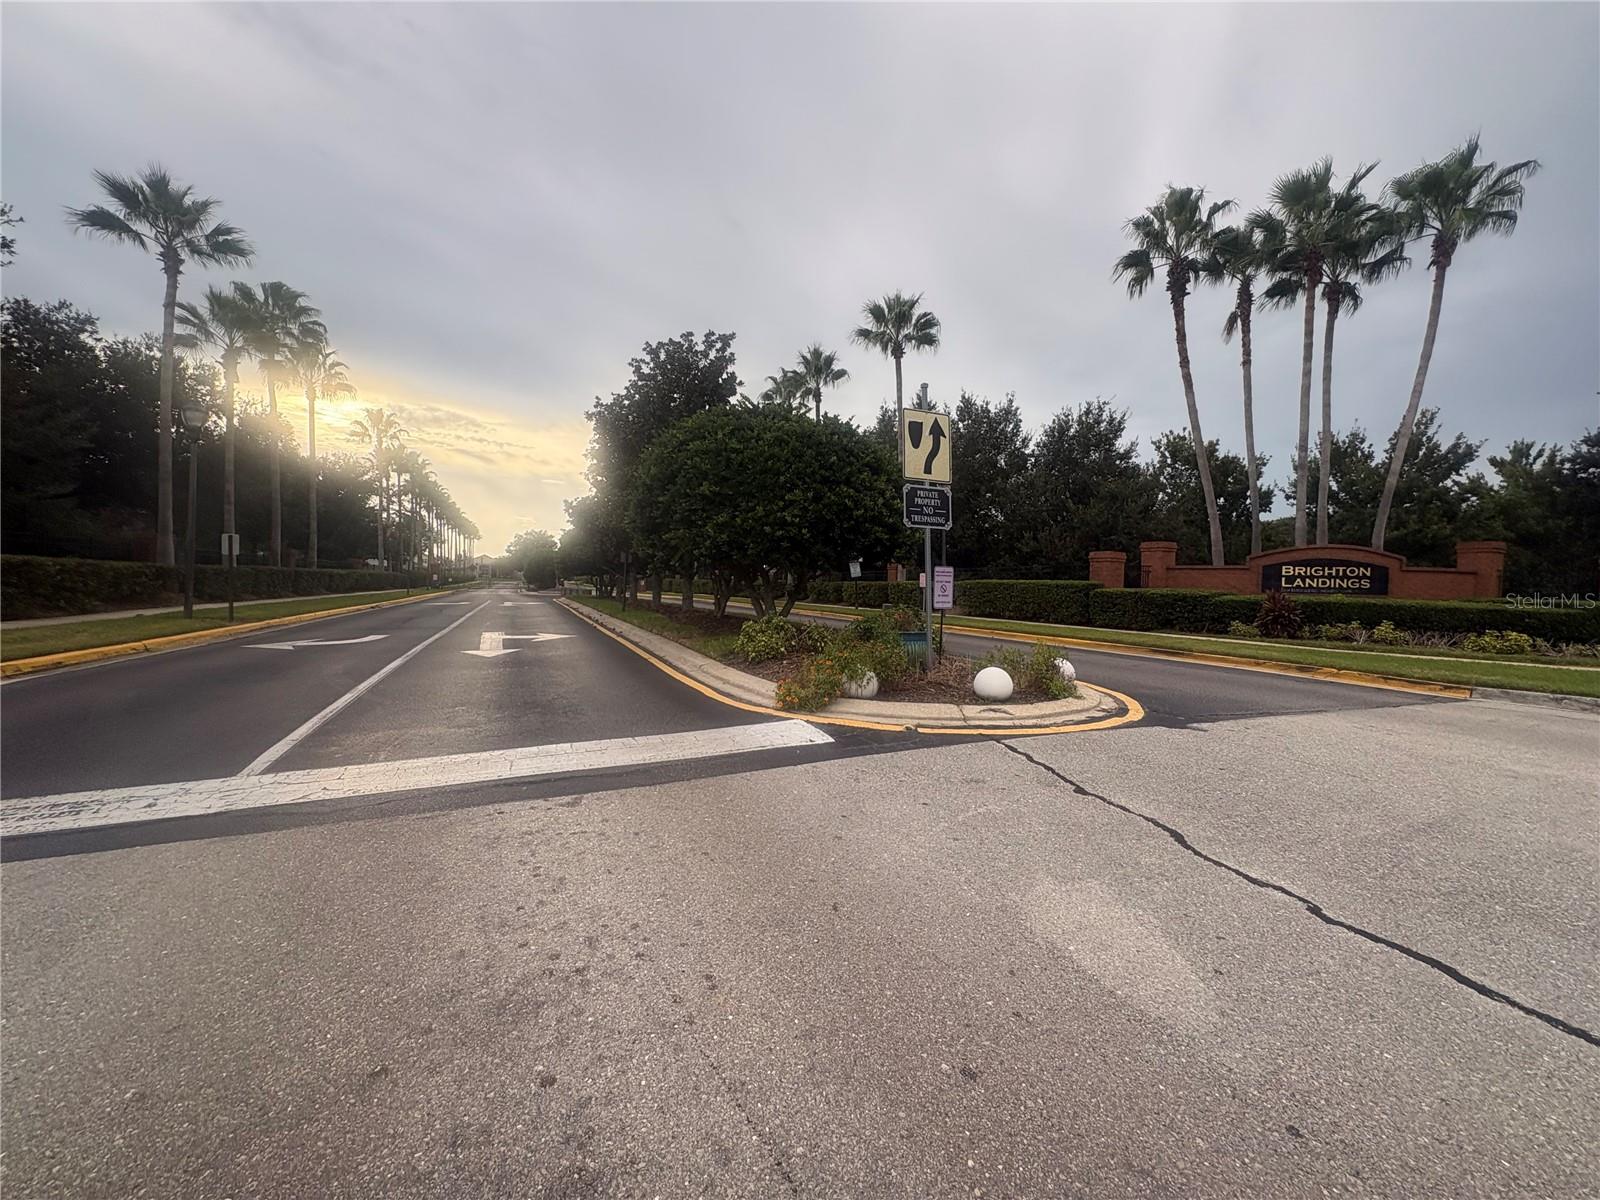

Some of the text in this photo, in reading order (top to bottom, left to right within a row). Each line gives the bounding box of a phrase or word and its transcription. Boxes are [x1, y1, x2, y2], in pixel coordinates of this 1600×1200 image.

[917, 490, 939, 499] PRIVATE
[914, 497, 941, 507] PROPERTY
[922, 506, 934, 515] NO
[911, 514, 946, 524] TRESPASSING
[1281, 565, 1371, 577] BRIGHTON
[1281, 577, 1371, 589] LANDINGS
